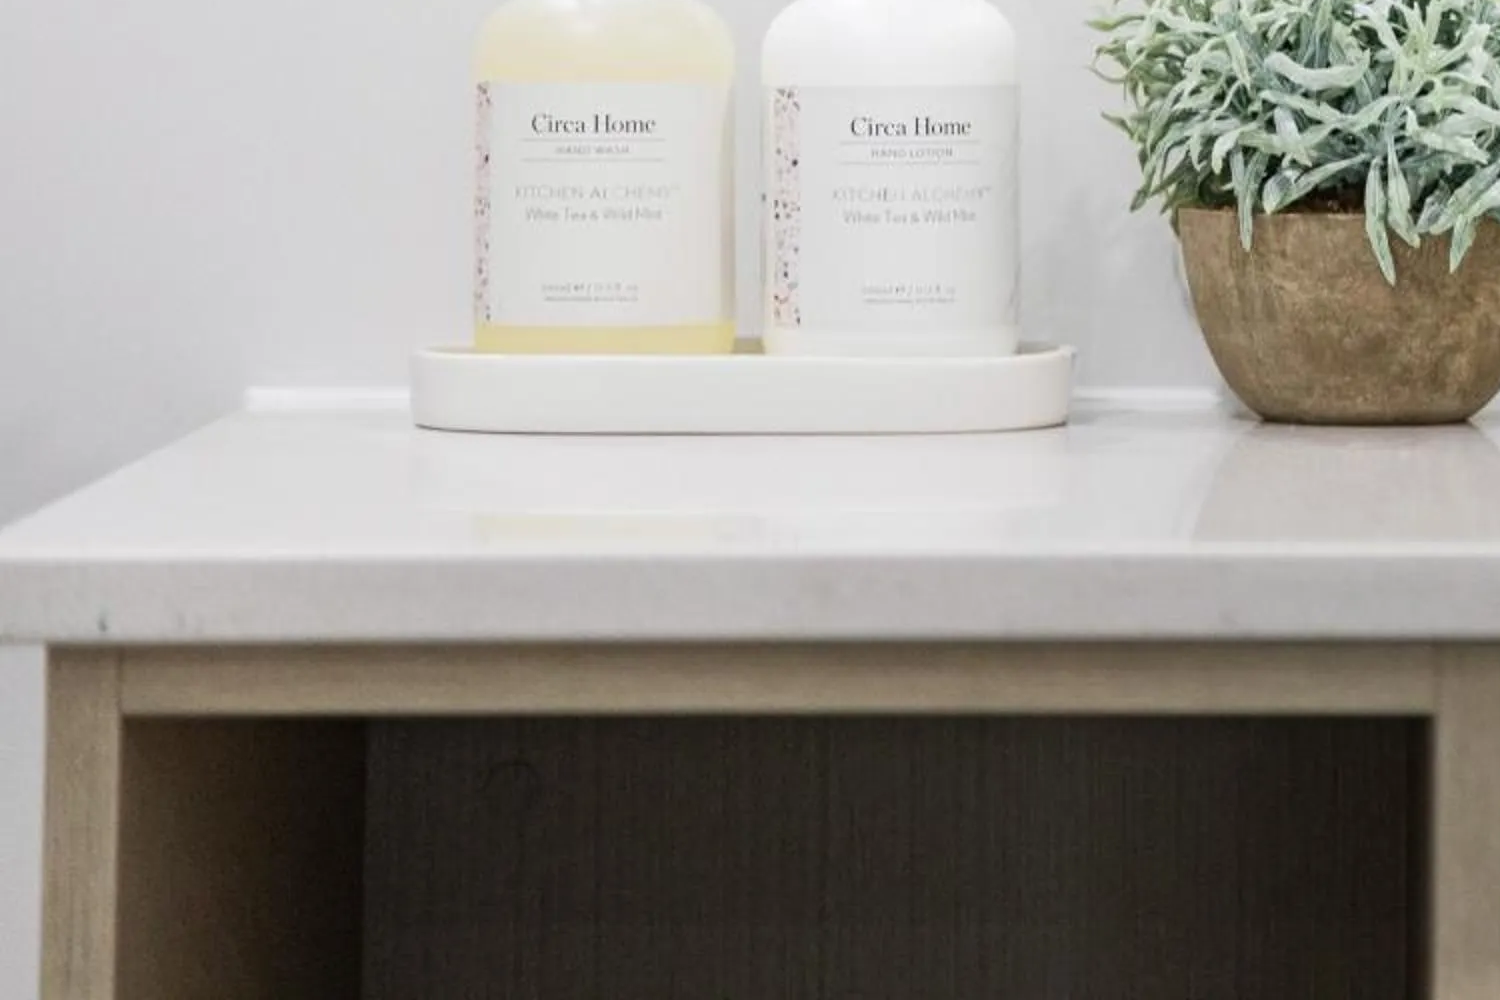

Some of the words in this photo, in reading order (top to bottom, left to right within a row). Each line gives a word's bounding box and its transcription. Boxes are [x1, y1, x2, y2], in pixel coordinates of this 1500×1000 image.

[531, 113, 586, 134] Circa
[593, 113, 656, 134] Home
[850, 116, 907, 137] Circa
[914, 116, 972, 137] Home
[871, 148, 907, 158] HAND
[909, 148, 953, 159] LOTION
